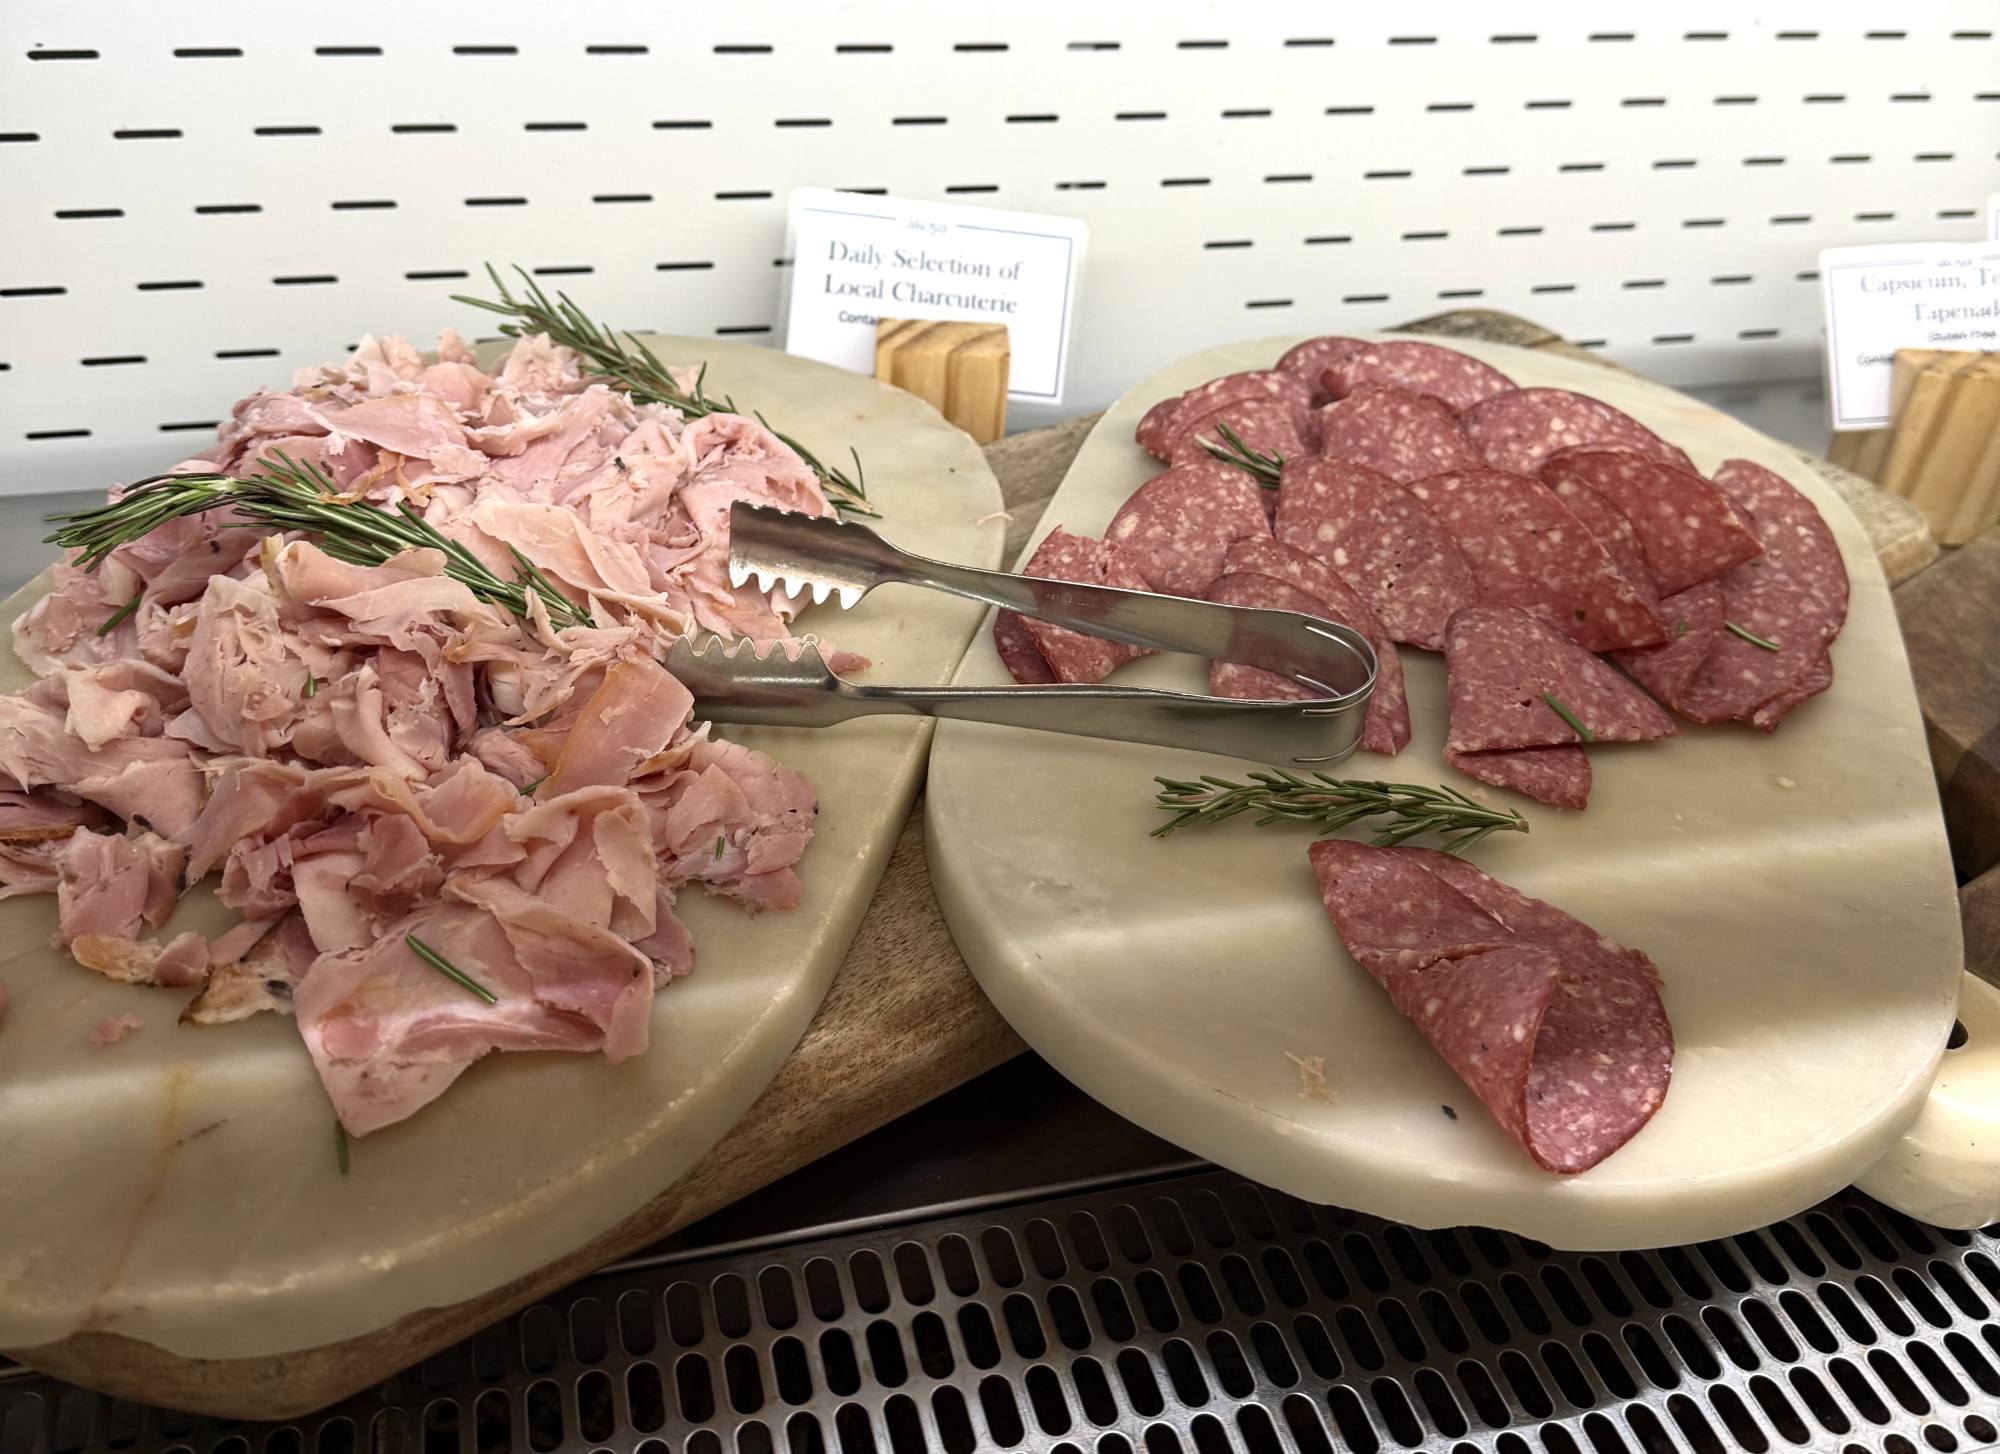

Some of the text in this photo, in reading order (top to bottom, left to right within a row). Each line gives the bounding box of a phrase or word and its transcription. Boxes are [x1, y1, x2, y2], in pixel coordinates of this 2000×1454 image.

[828, 240, 1024, 281] Daily Selection of
[824, 273, 1018, 313] Local Charcuterie
[838, 309, 877, 326] Conta
[1907, 297, 2000, 325] Tapenad
